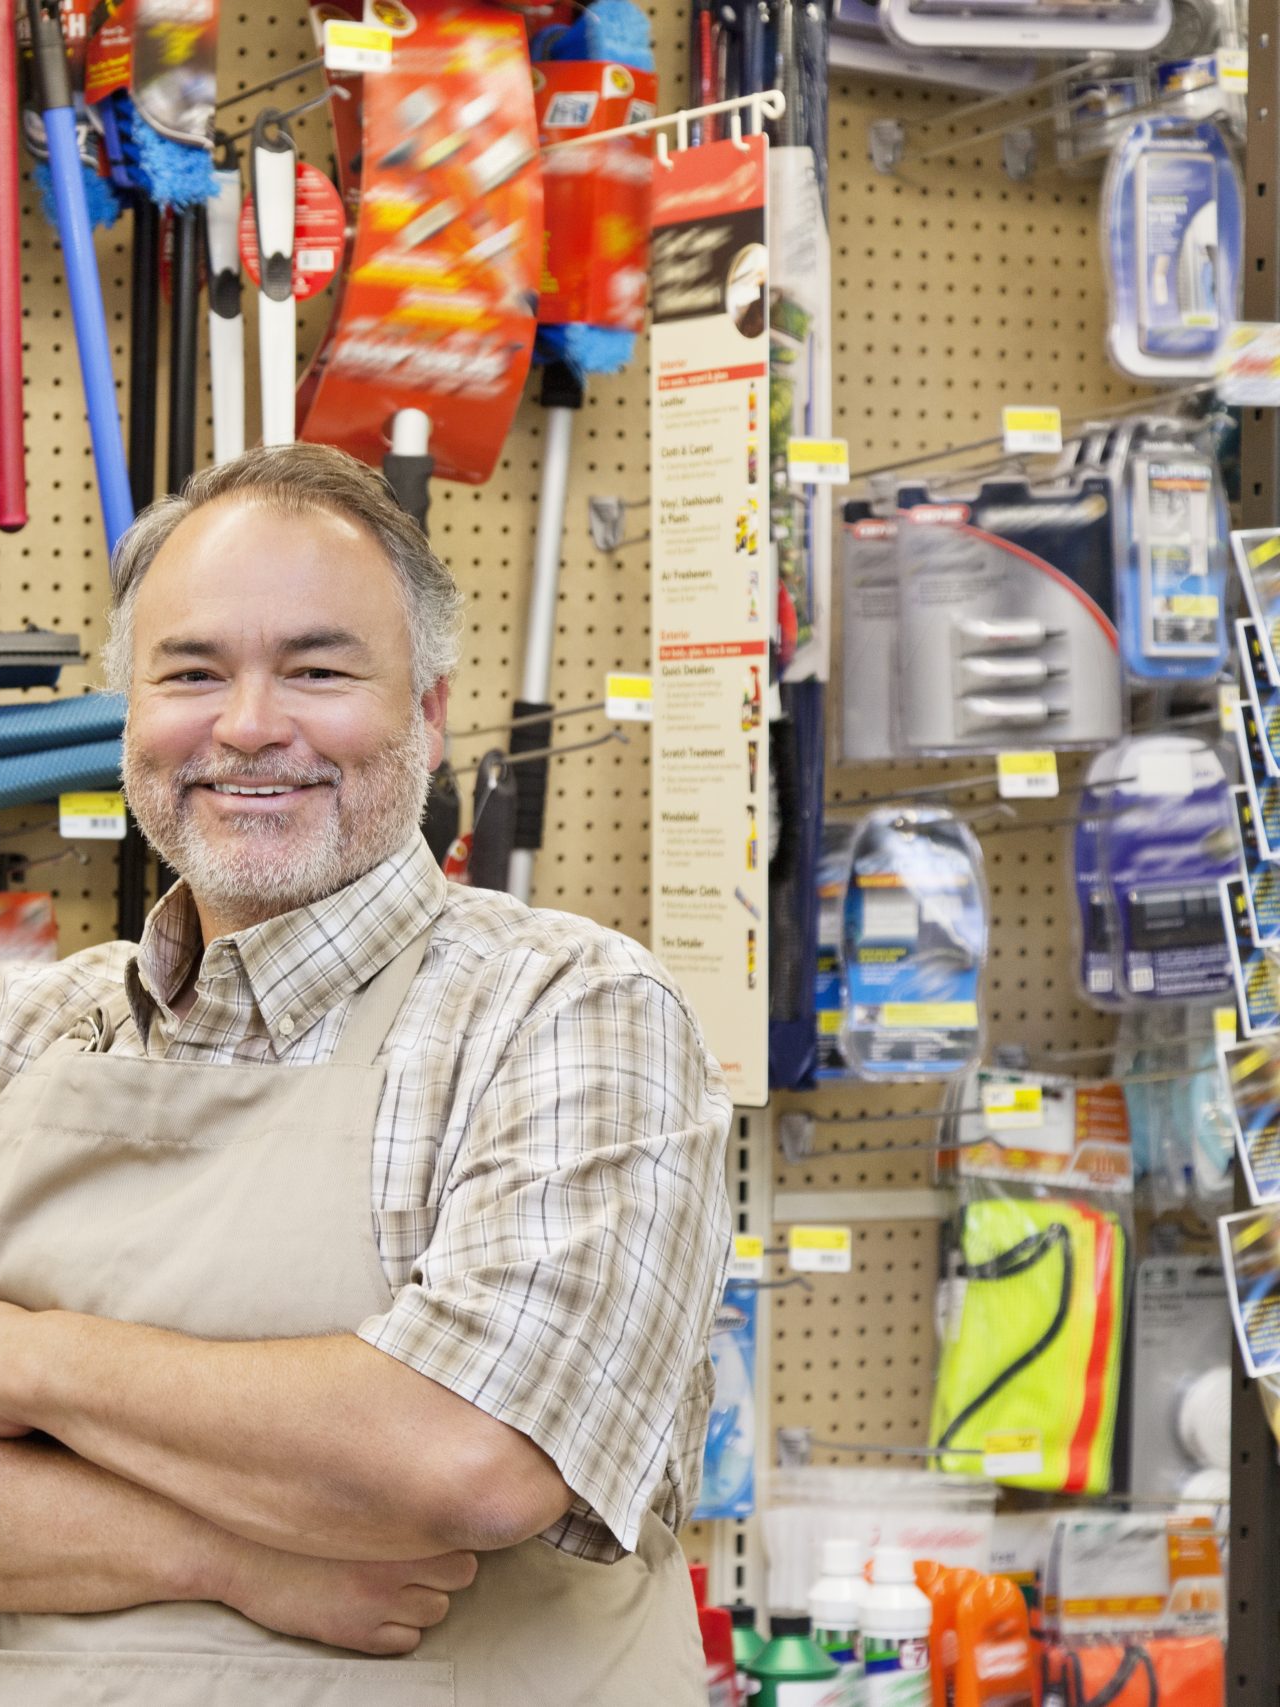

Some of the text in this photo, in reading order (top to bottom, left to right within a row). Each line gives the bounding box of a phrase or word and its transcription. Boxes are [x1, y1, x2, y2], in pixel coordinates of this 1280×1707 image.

[661, 445, 680, 458] Cloth
[689, 442, 713, 457] Carpet
[681, 494, 724, 509] Dashboards
[673, 568, 713, 581] Fresheners
[660, 630, 689, 641] Exterior
[661, 664, 681, 677] Quick
[661, 747, 726, 760] Scratch Treatment
[661, 885, 698, 897] Microfiber
